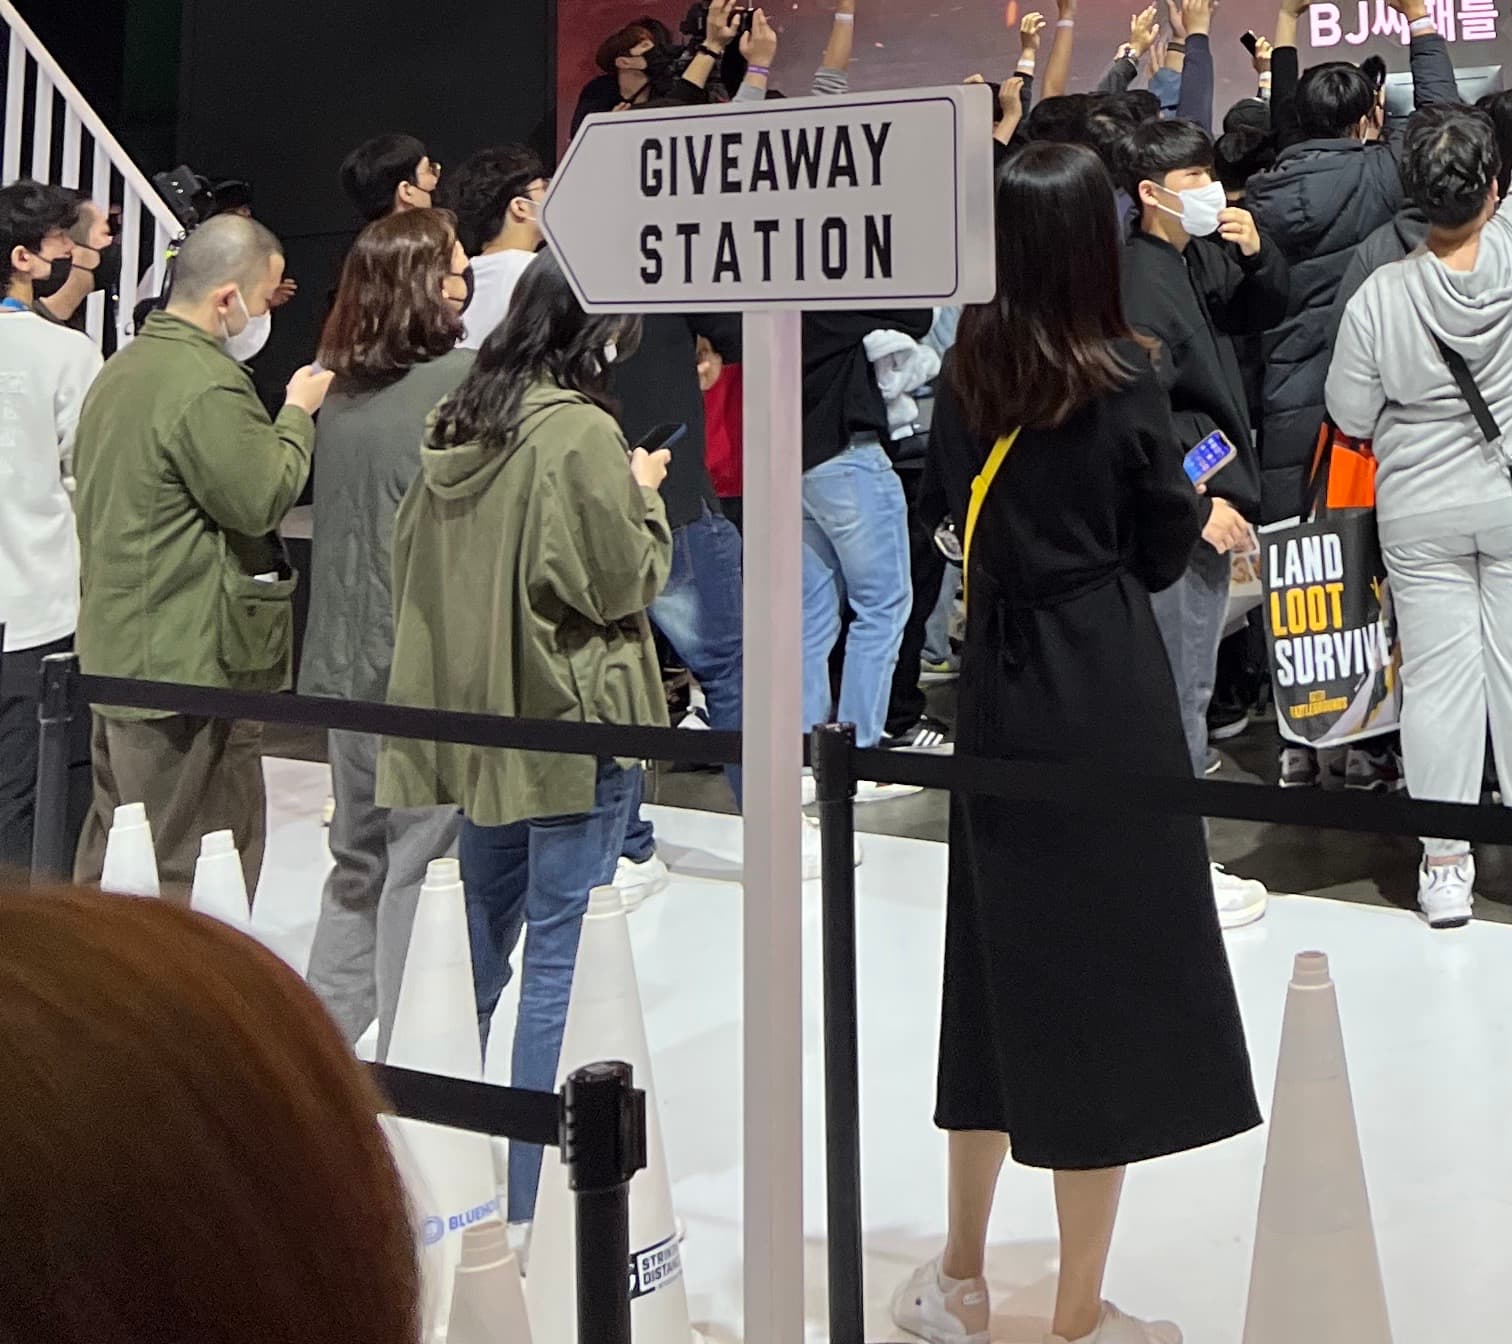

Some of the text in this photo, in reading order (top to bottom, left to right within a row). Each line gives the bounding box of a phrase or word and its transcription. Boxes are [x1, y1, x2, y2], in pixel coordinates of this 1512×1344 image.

[639, 121, 892, 198] GIVEAWAY
[639, 214, 893, 285] STATION
[1269, 533, 1344, 589] LAND
[1270, 582, 1344, 637] LOOT
